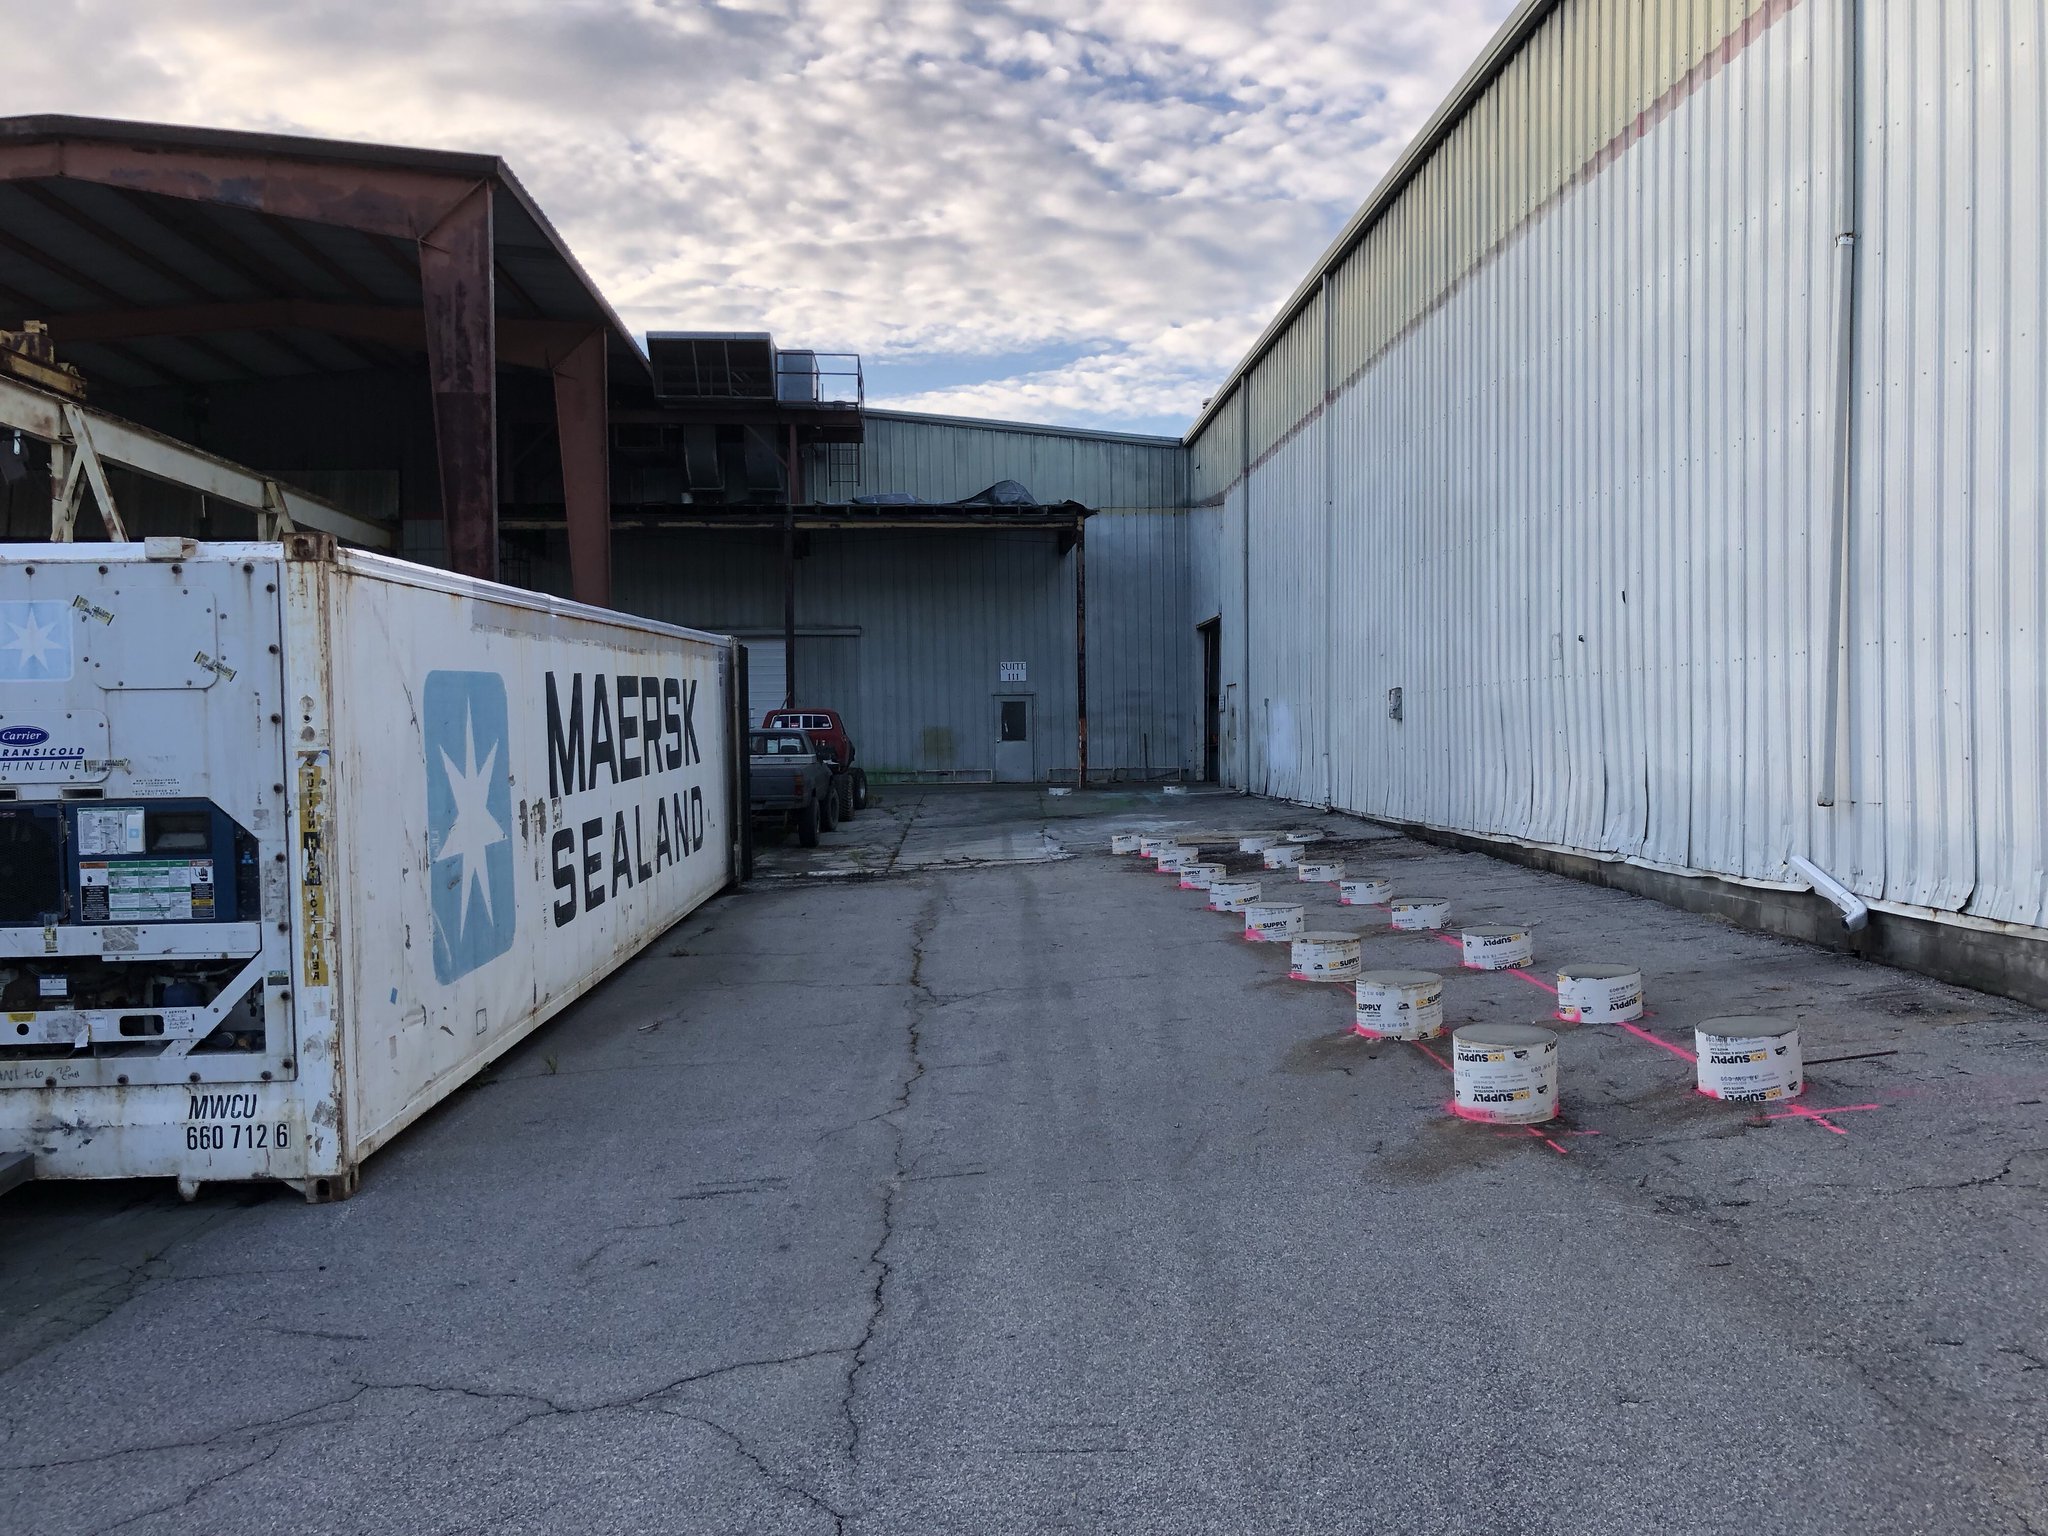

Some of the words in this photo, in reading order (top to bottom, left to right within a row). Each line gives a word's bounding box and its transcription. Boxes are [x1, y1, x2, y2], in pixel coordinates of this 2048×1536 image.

[2, 731, 42, 740] Carrier
[545, 671, 700, 799] MAERSK
[2, 747, 85, 756] RANSICOLD
[2, 760, 82, 771] HINLINE
[552, 785, 704, 928] SEALAND
[1483, 937, 1512, 946] SUPPLY
[1340, 956, 1360, 966] SUPPLY
[1494, 962, 1521, 970] SUPPLY
[1608, 996, 1637, 1011] SUPPLY
[1457, 1053, 1488, 1063] SUPPLY
[1710, 1055, 1750, 1064] SUPPLY
[1472, 1093, 1514, 1102] SUPPLY
[1725, 1092, 1766, 1101] SUPPLY
[188, 1094, 258, 1120] MWCU
[186, 1125, 224, 1150] 660
[230, 1124, 268, 1148] 712
[276, 1123, 288, 1148] 6
